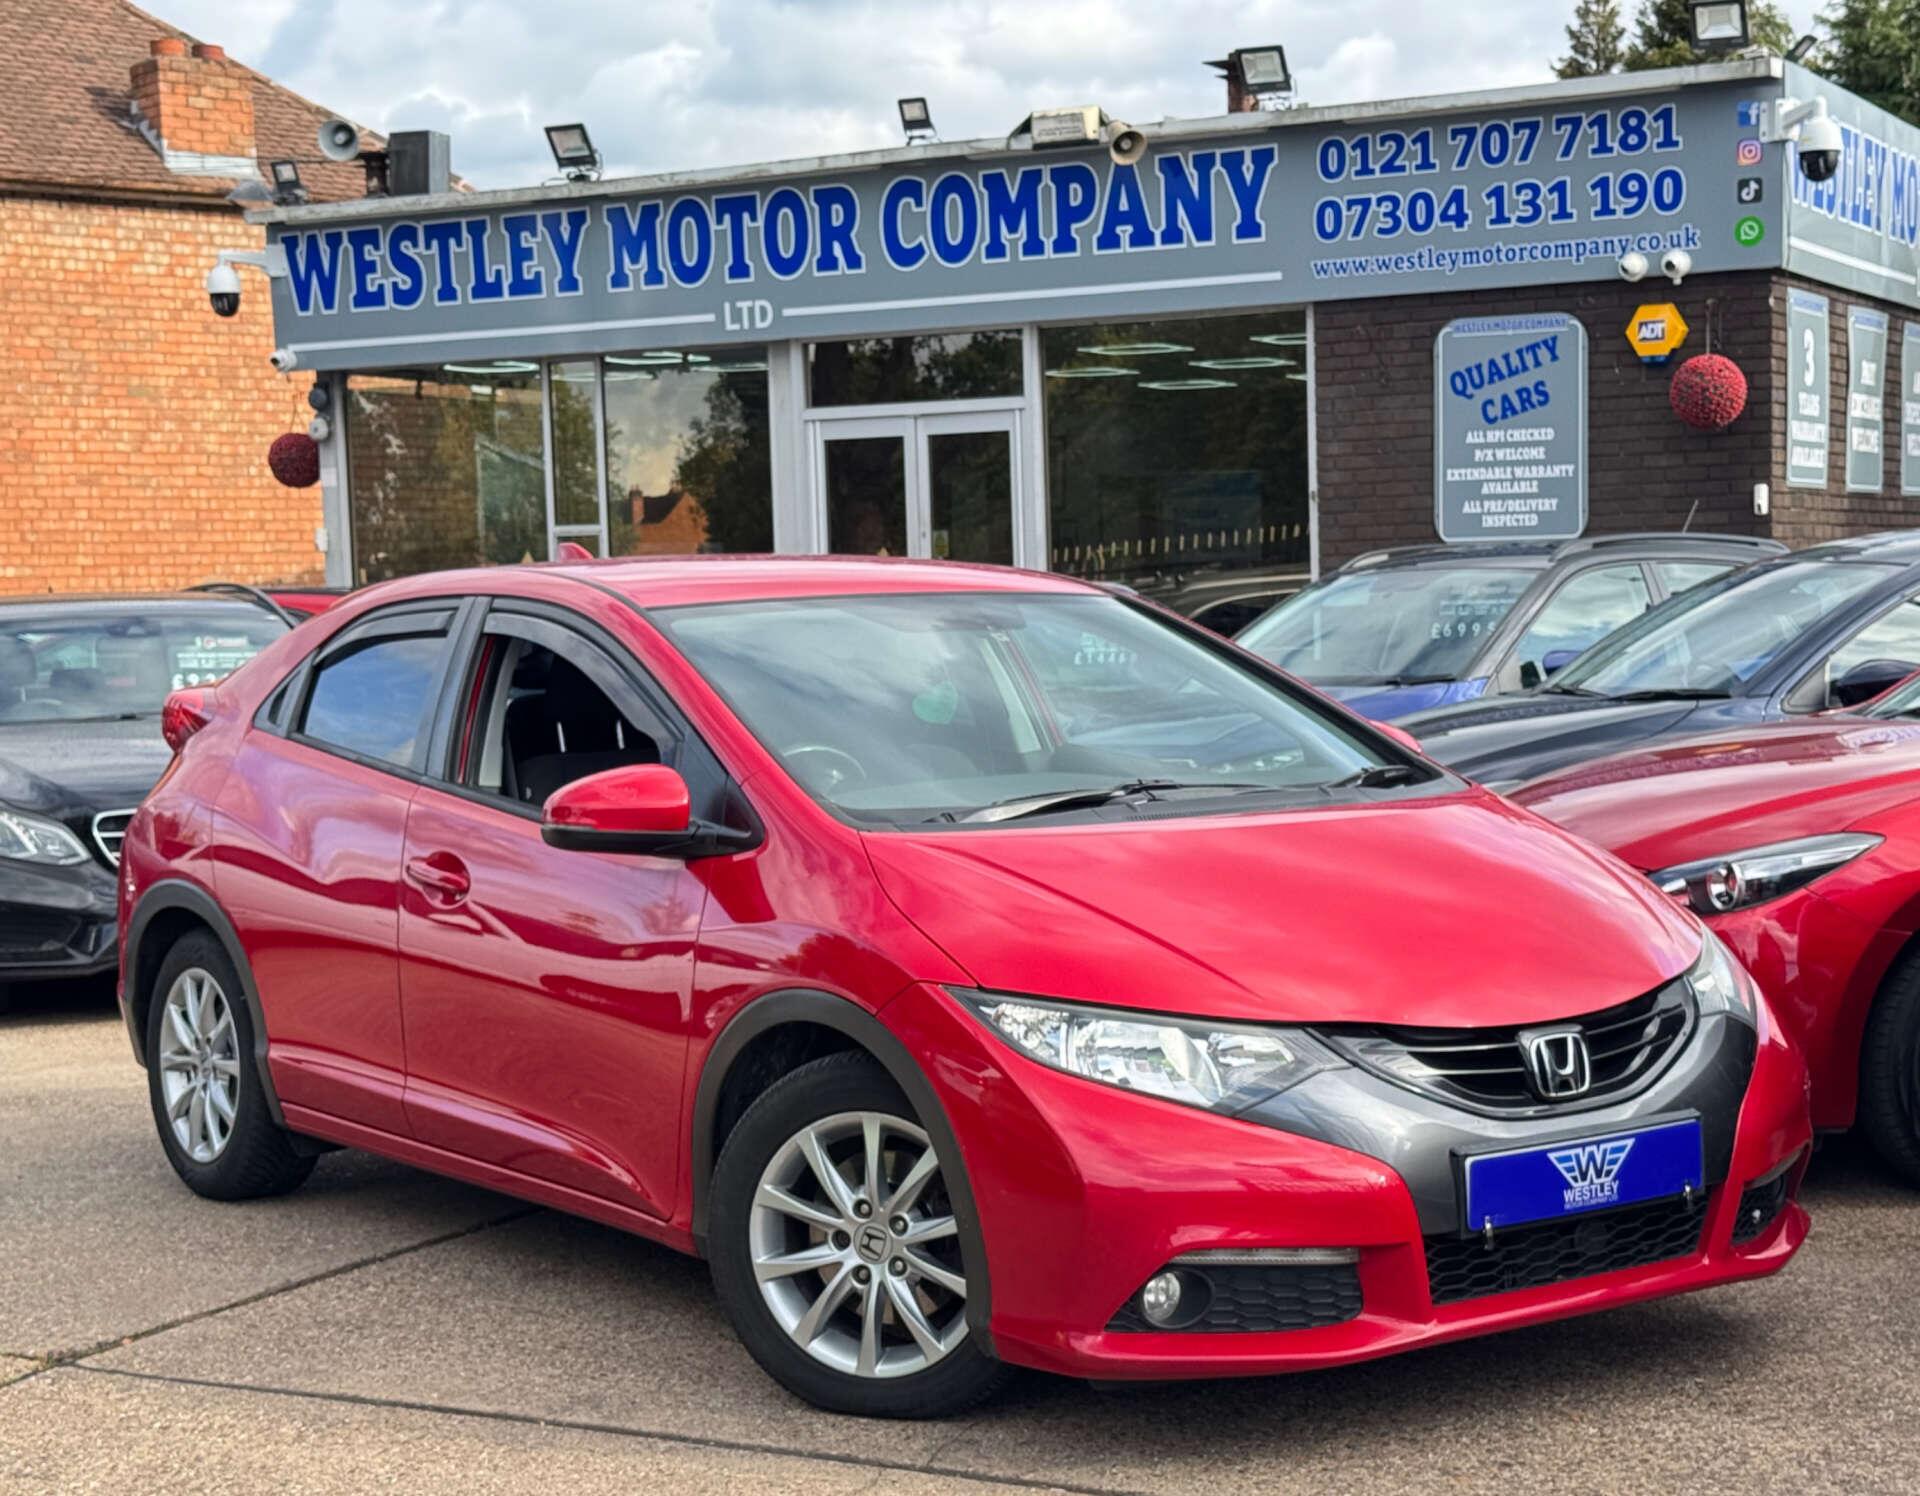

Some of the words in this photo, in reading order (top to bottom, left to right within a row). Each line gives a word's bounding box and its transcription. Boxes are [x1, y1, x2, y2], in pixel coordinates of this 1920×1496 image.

[1317, 129, 1438, 181] 0121
[1449, 118, 1541, 170] 707
[1553, 104, 1682, 160] 7181
[1314, 186, 1470, 243] 07304
[1485, 179, 1574, 227] 131
[1588, 166, 1686, 219] 190
[1889, 146, 1920, 248] MO
[281, 208, 589, 316] WESTLEY
[604, 183, 865, 291] MOTOR
[880, 144, 1278, 271] COMPANY
[1312, 225, 1701, 279] www.westleymotorcompany.co.uk
[723, 300, 775, 331] LTD
[1639, 322, 1665, 340] ADT
[1450, 336, 1560, 399] QUALITY
[1804, 328, 1815, 387] 3
[1481, 380, 1550, 425] CARS
[1465, 430, 1485, 444] ALL
[1506, 427, 1555, 442] CHECKED
[1495, 446, 1546, 461] WELCOME
[1446, 466, 1513, 481] EXTENDABLE
[1513, 464, 1575, 479] WARRANTY
[1481, 480, 1538, 494] AVAILABLE
[1462, 500, 1482, 513] ALL
[1482, 498, 1558, 513] PRE/DELIVERY
[1482, 514, 1539, 527] INSPECTED
[1564, 1180, 1619, 1203] WESTLEY
